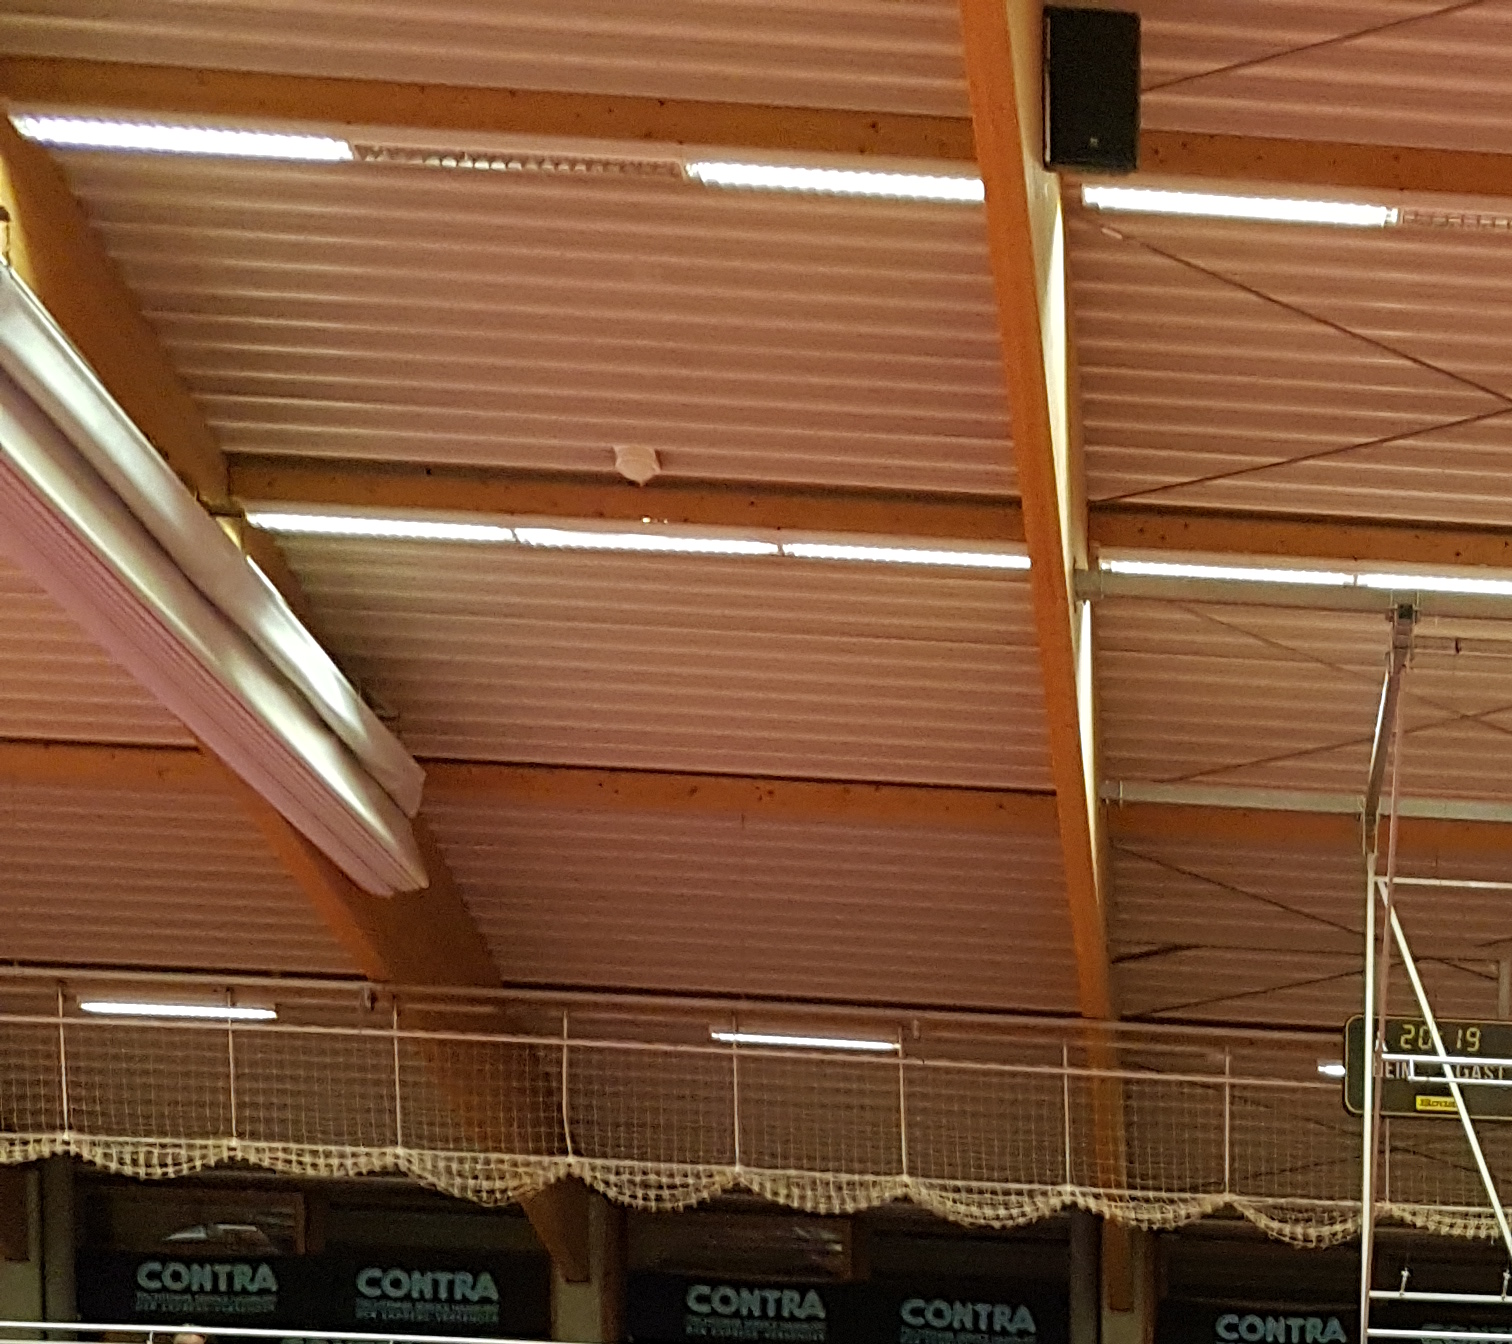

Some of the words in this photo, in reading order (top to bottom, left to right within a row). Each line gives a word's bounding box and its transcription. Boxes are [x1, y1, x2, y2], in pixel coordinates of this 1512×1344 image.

[136, 1261, 279, 1293] CONTRA
[356, 1267, 499, 1301] CONTRA
[686, 1285, 826, 1319] CONTRA
[901, 1298, 1036, 1335] CONTRA
[1215, 1314, 1347, 1344] CONTRA
